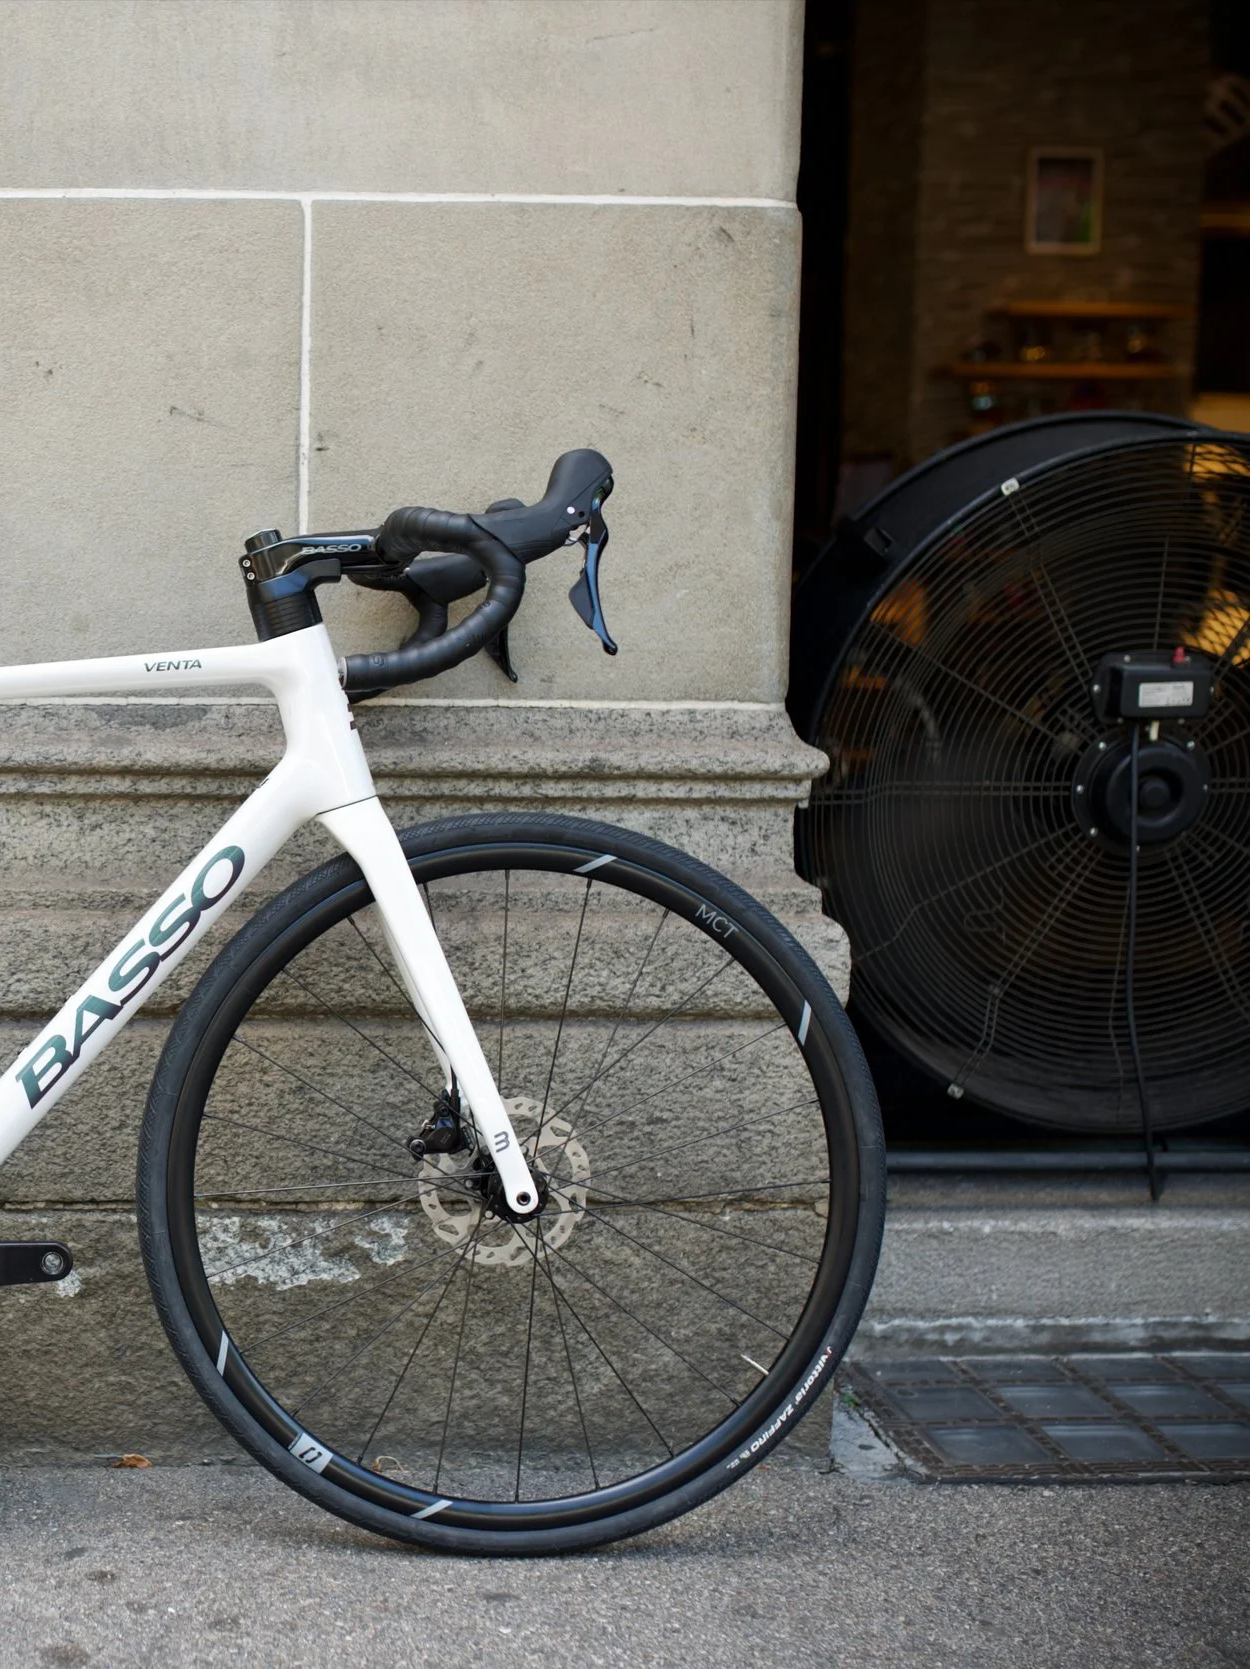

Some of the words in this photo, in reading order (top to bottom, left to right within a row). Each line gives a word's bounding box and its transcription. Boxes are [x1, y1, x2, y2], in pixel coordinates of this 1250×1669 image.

[144, 659, 202, 672] VENTA
[695, 904, 739, 938] MCT
[15, 845, 245, 1109] BASSO
[750, 1403, 794, 1453] ZAFFIRO
